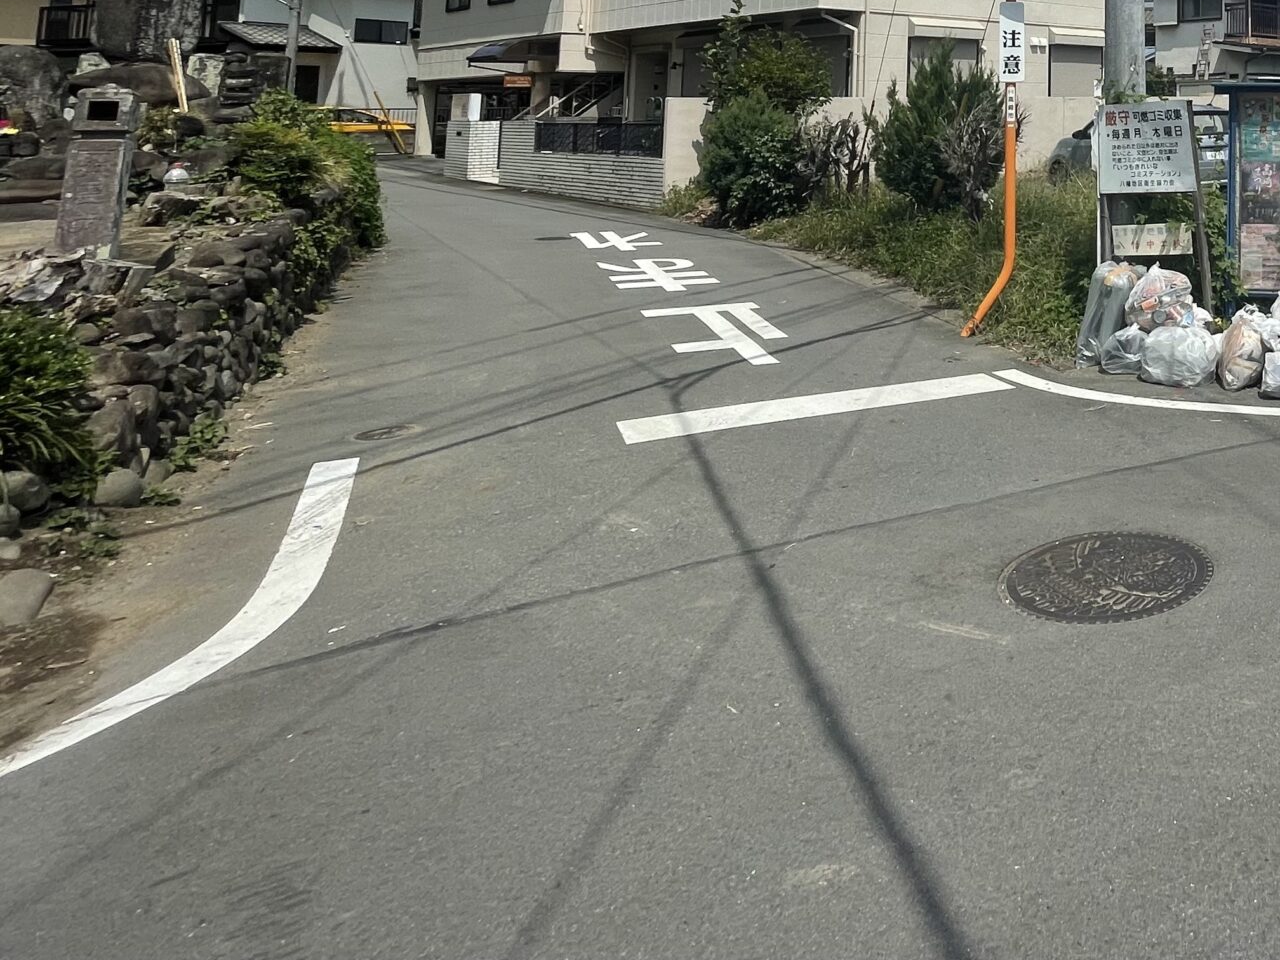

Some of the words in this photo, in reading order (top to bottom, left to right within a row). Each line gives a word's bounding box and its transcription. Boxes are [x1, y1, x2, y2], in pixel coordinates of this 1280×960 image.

[1002, 30, 1021, 74] 注意
[1105, 110, 1130, 126] 厳守
[1132, 109, 1182, 123] 可燃ゴミ収集
[1130, 170, 1182, 178] ゴミステーション」
[569, 231, 788, 365] 止まれ
